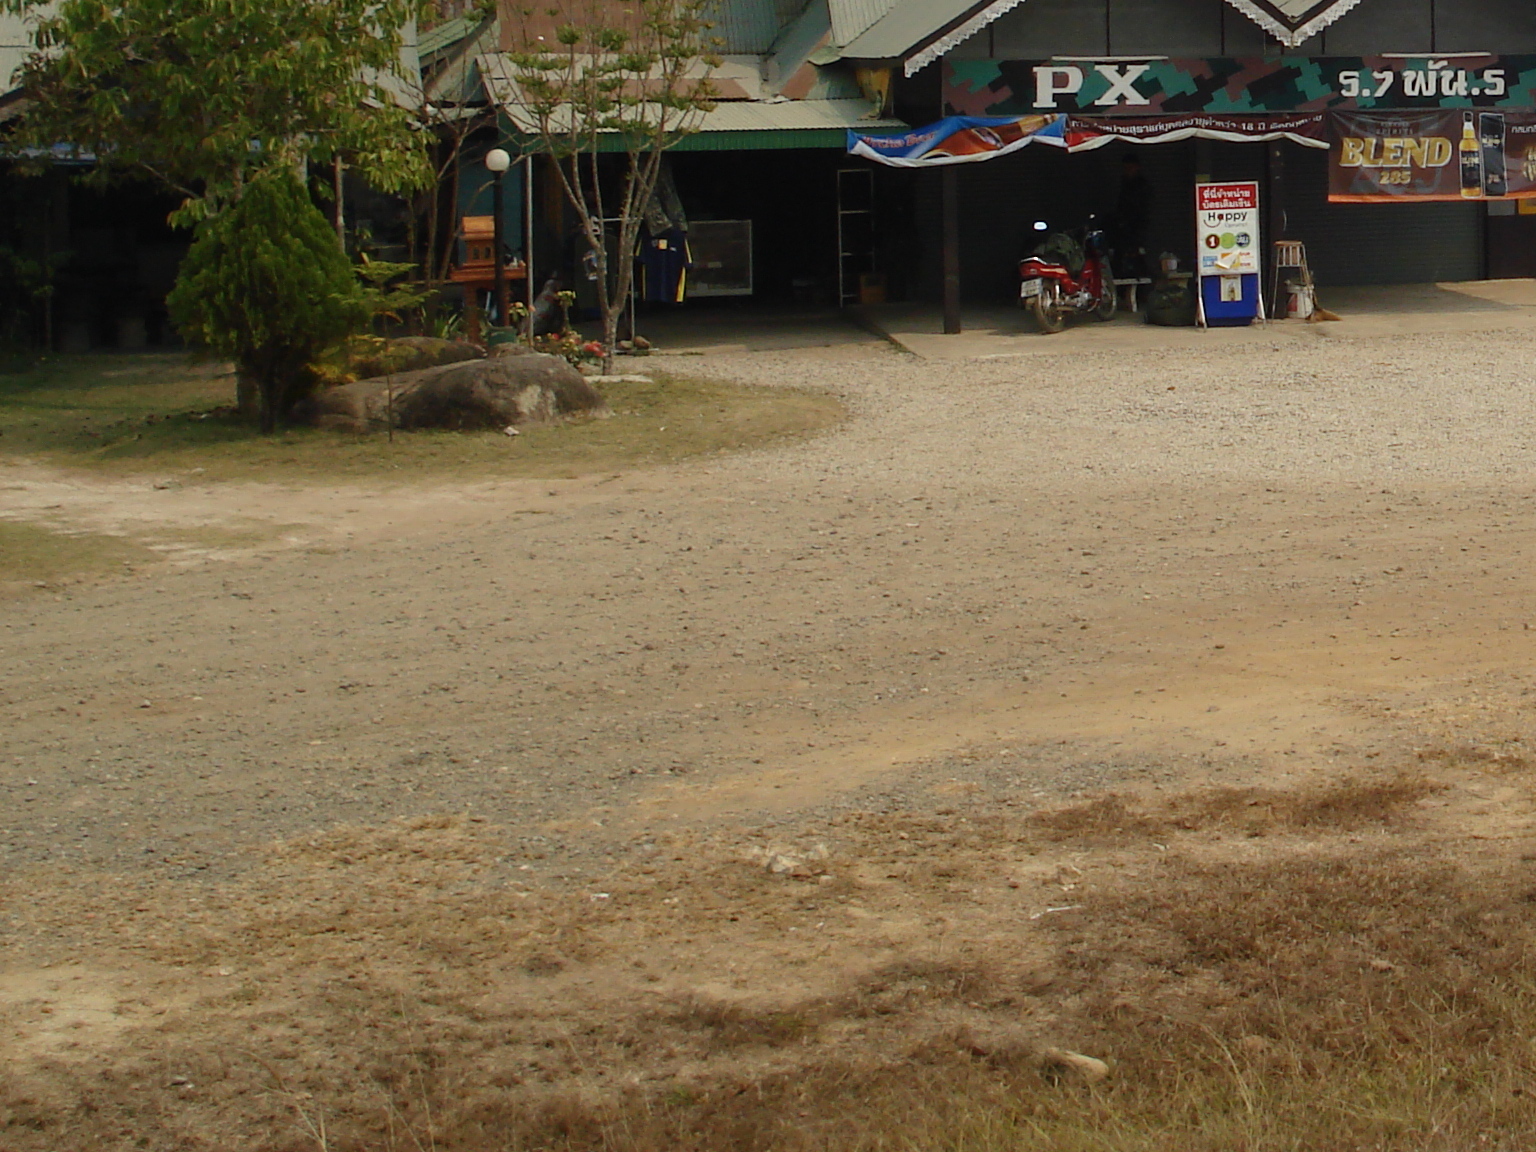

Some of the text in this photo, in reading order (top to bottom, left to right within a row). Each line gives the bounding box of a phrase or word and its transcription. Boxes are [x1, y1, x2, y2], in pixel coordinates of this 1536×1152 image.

[1032, 64, 1150, 108] PX
[1241, 121, 1254, 131] 18
[1339, 136, 1453, 169] BLEND
[1379, 171, 1412, 185] 285
[1208, 211, 1248, 223] Happy
